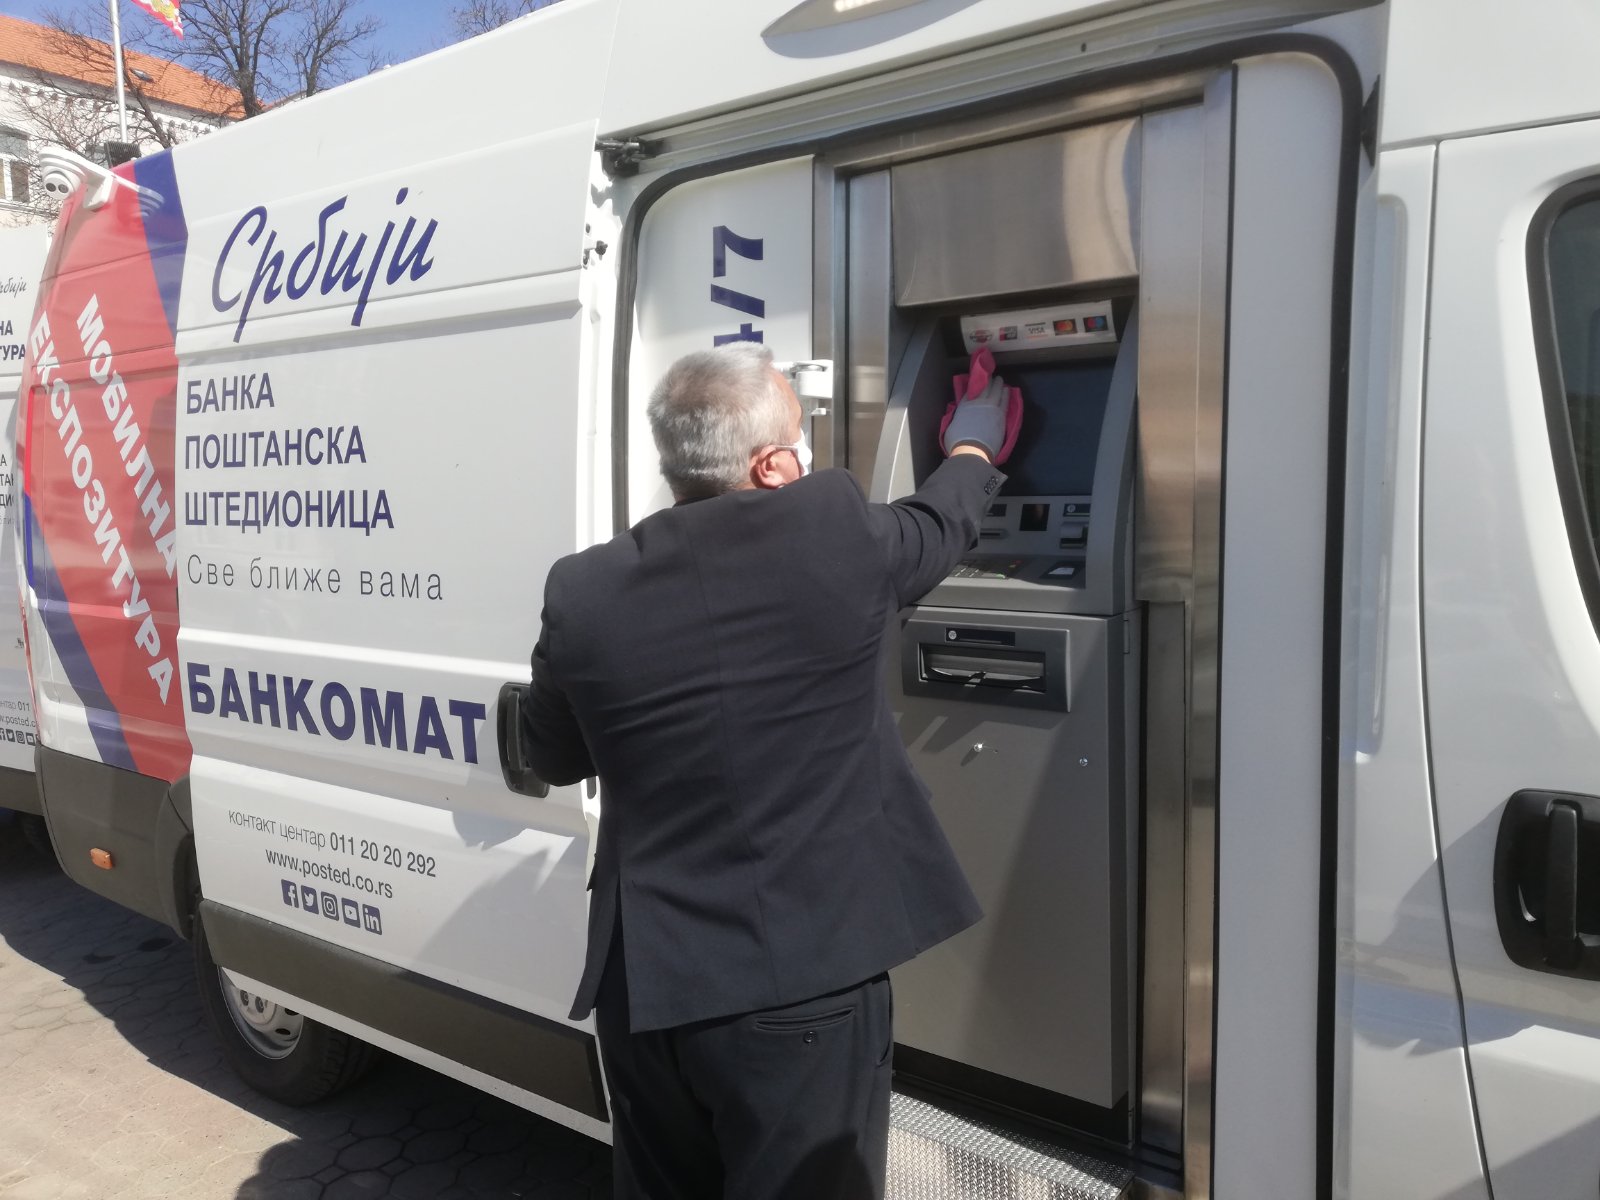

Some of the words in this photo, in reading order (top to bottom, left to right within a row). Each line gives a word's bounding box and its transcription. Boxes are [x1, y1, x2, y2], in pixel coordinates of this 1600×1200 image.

[212, 187, 438, 343] Србији
[186, 372, 275, 414] БАНКА
[77, 294, 177, 578] МОБИЛНА
[185, 425, 367, 469] ПОШТАНСКА
[31, 311, 173, 705] ЕКСПОЗИТУРА
[185, 489, 395, 536] ШТЕДИОНИЦА
[187, 554, 235, 587] Све
[250, 556, 341, 594] ближе
[360, 570, 443, 600] вама
[187, 662, 487, 764] БАНКОМАТ
[228, 810, 277, 835] контакт
[279, 825, 326, 849] центар
[330, 832, 355, 856] 011
[360, 839, 379, 862] 20
[383, 845, 402, 868] 20
[407, 851, 437, 878] 292
[265, 849, 393, 899] www.posted.co.rs
